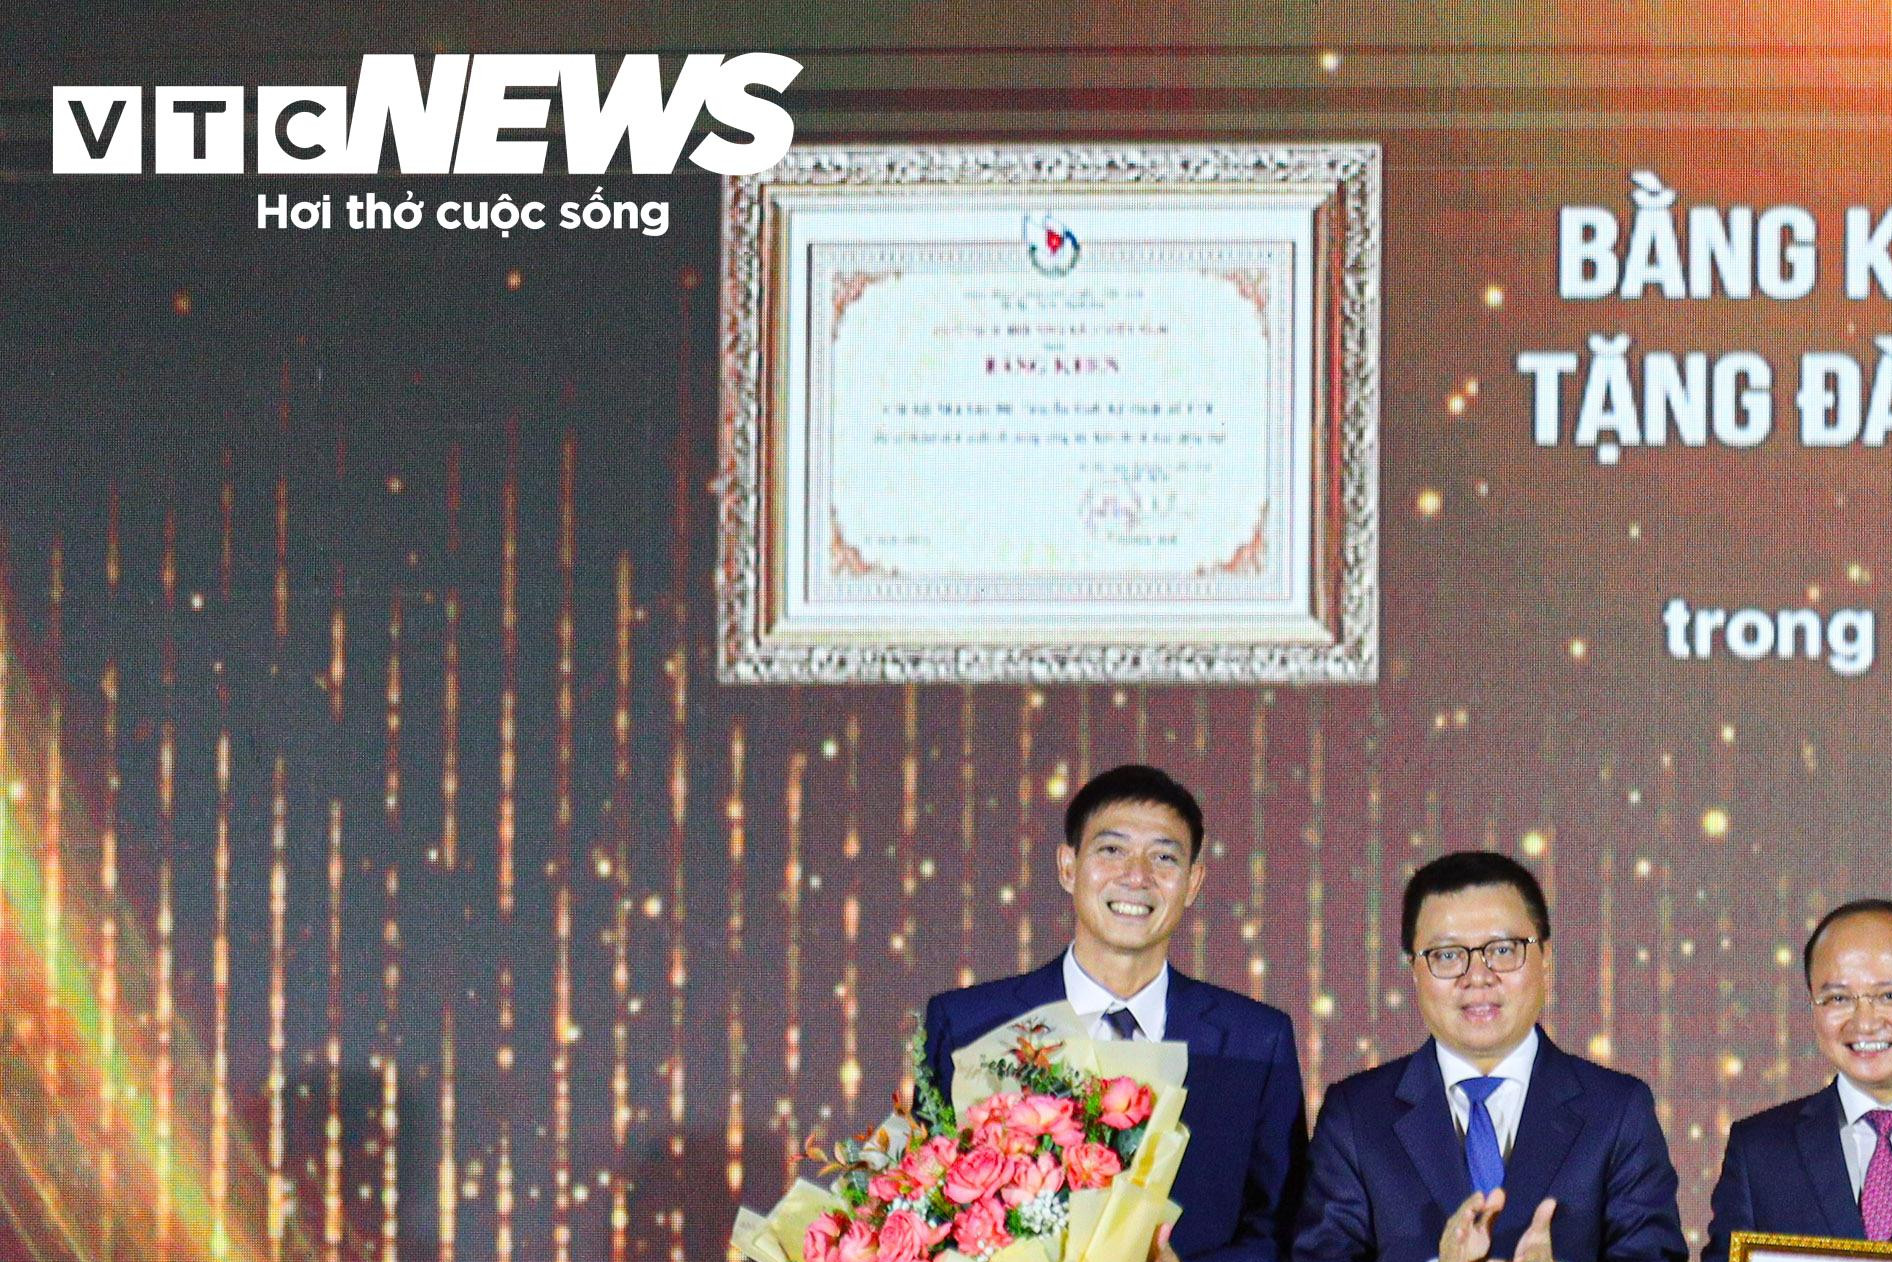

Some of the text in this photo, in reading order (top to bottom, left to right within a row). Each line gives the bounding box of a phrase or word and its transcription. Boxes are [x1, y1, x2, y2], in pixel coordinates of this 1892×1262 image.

[1558, 169, 1818, 301] BẰNG
[1516, 332, 1773, 466] TẶNG
[1662, 598, 1875, 677] trong
